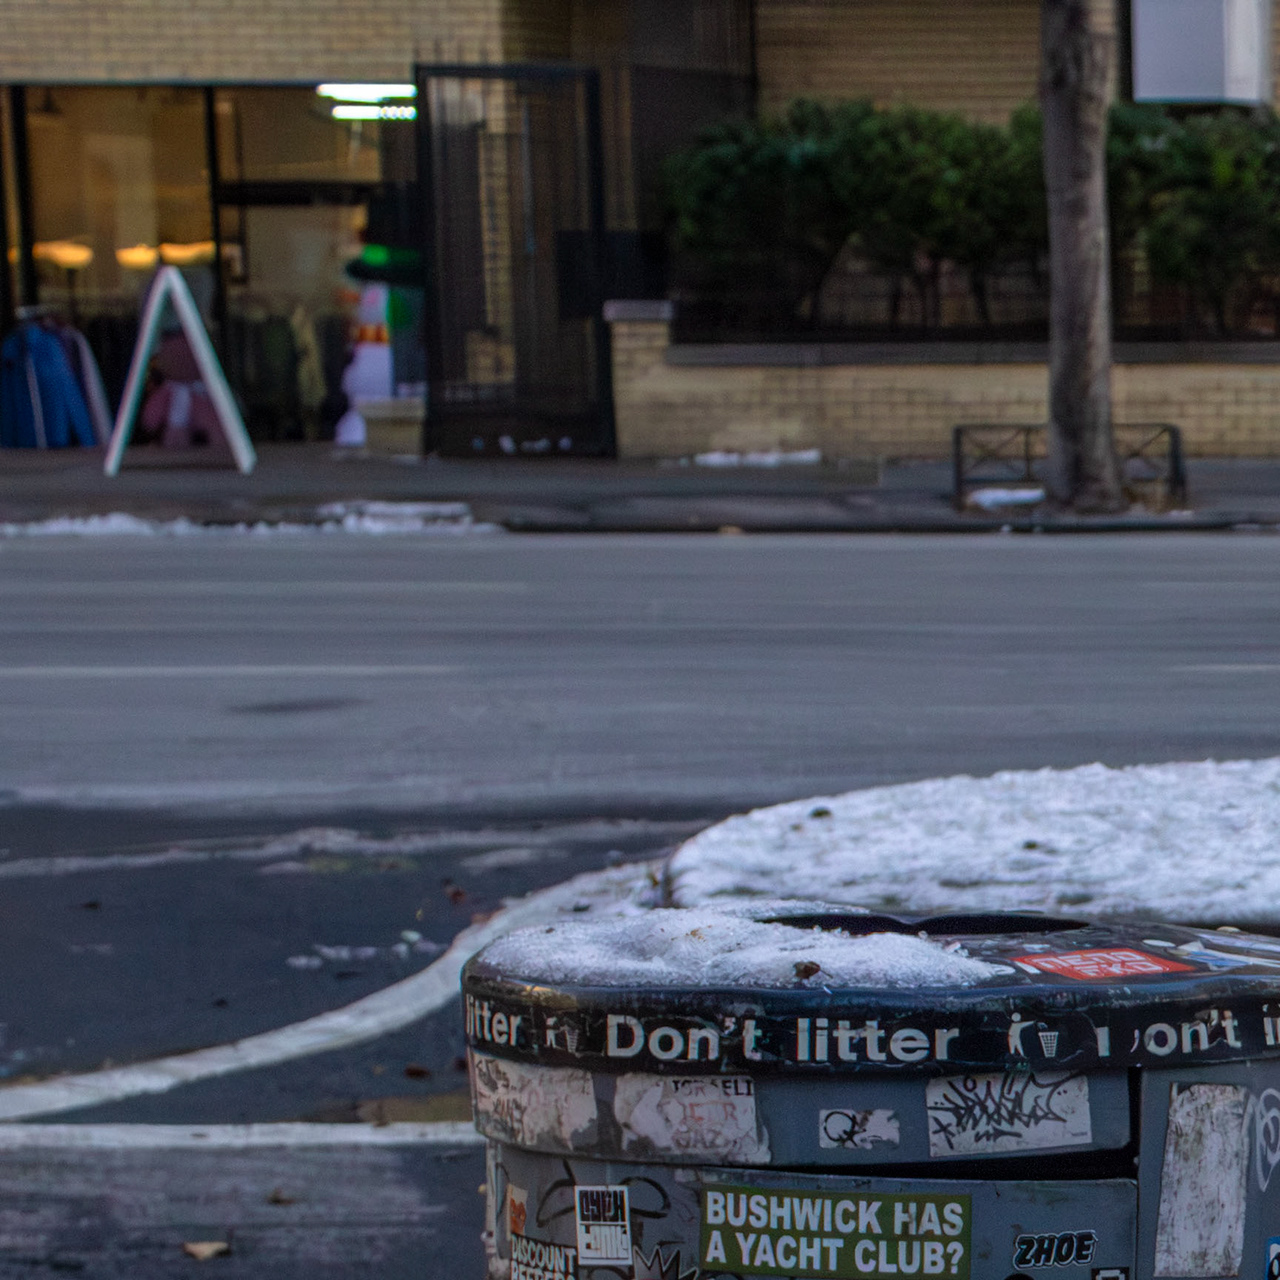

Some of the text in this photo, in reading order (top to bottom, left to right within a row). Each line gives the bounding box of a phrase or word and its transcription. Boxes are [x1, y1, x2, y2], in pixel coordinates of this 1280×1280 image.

[606, 1013, 764, 1062] Don't
[796, 1017, 960, 1063] litter
[706, 1190, 965, 1237] BUSHWICK HAS
[511, 1233, 577, 1273] DISCOUNT
[705, 1230, 965, 1275] A YACHT CLUB?
[1014, 1231, 1097, 1270] ZHOE
